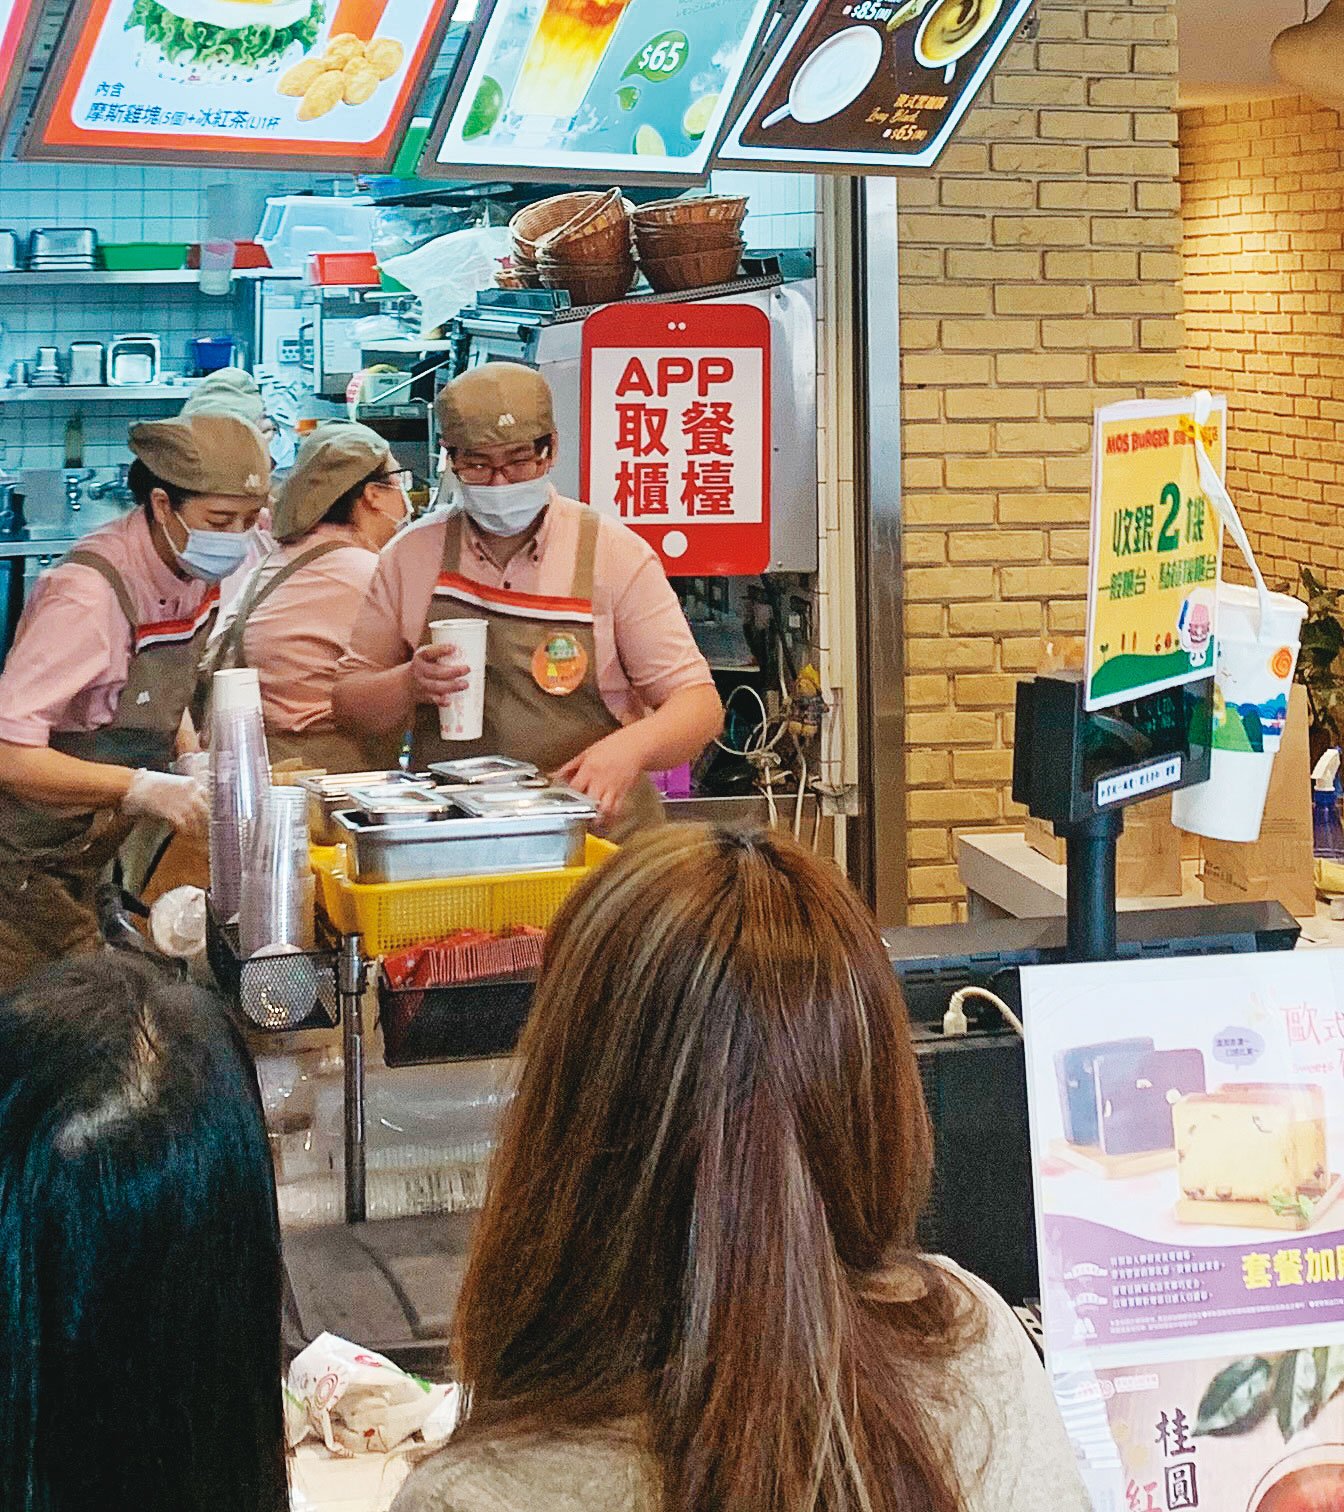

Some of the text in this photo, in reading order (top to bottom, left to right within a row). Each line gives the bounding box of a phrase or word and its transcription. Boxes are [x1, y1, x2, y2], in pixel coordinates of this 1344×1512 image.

[638, 39, 687, 74] $65
[615, 356, 735, 398] APP
[614, 401, 735, 458] 取餐
[1106, 434, 1130, 455] MOS
[1131, 428, 1169, 454] BURGER
[1112, 482, 1206, 557] 收銀2機
[1154, 1407, 1200, 1511] 桂圓
